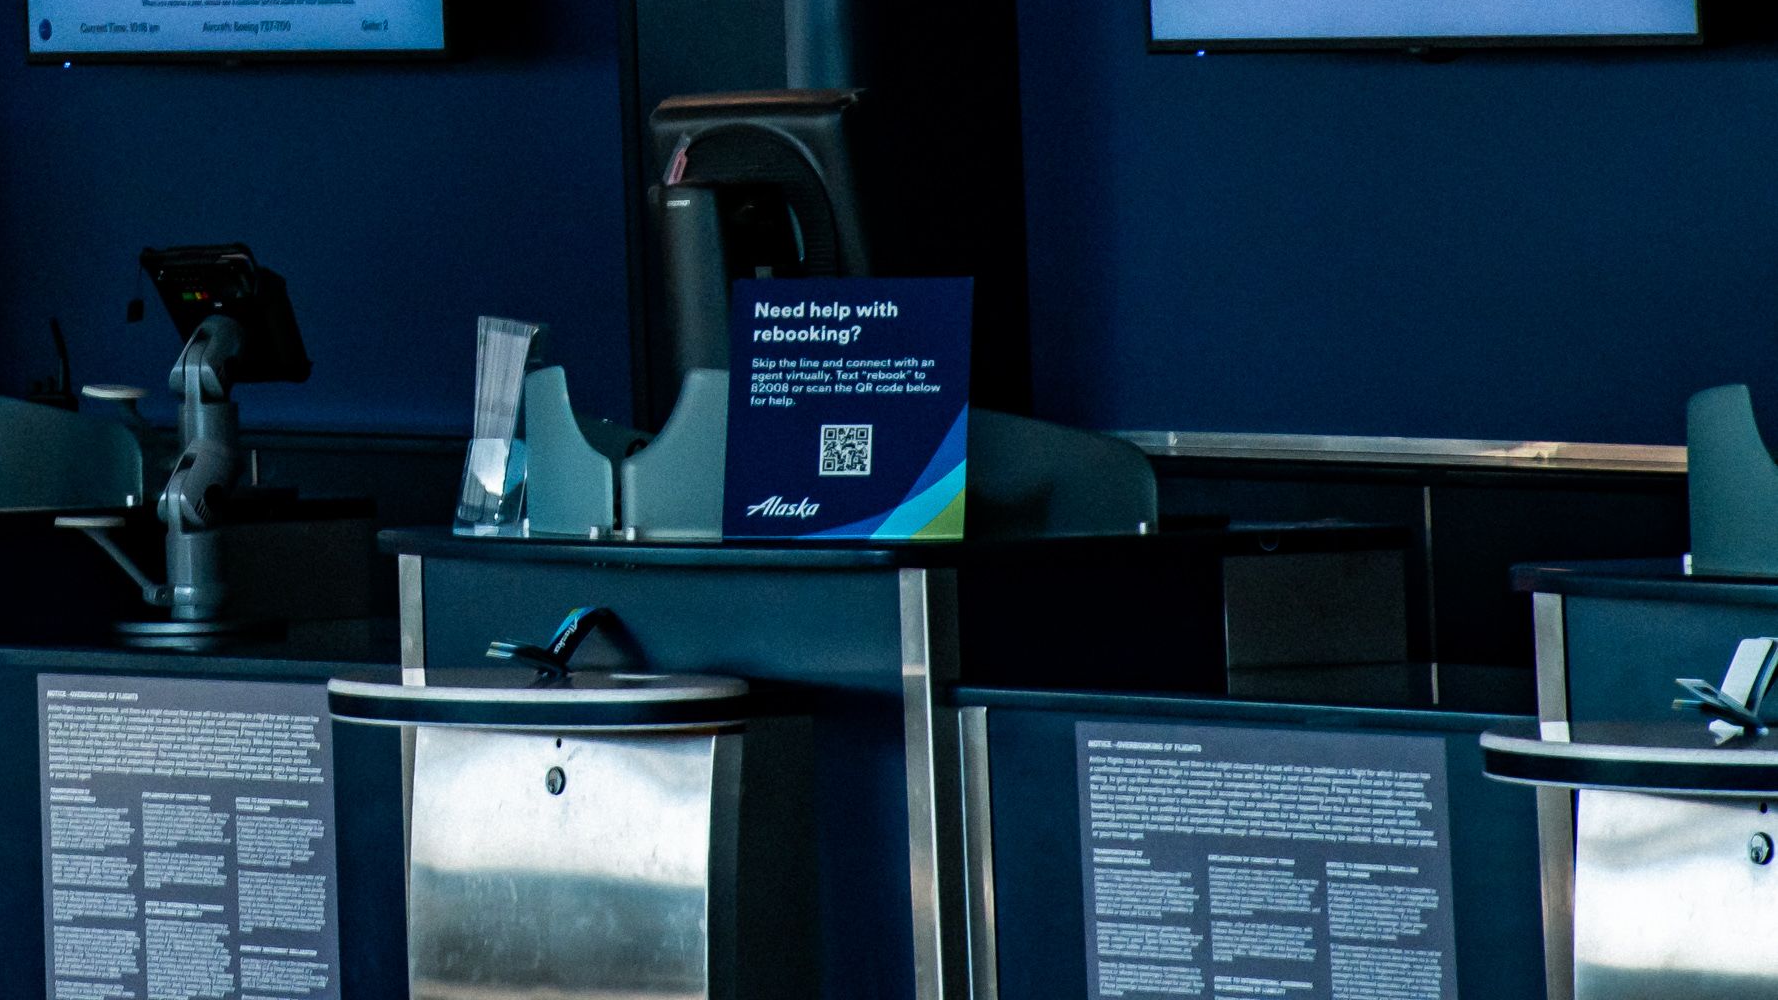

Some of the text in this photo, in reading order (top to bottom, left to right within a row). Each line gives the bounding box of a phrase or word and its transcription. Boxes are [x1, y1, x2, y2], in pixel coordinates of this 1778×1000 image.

[754, 301, 899, 322] Need help with
[753, 325, 862, 345] rebooking?
[752, 357, 935, 370] Skip the line and connect with an
[751, 371, 783, 383] agent
[785, 370, 833, 384] virtually.
[836, 370, 859, 380] Text
[914, 370, 926, 380] to
[792, 385, 803, 394] or
[806, 384, 832, 394] scan
[835, 383, 853, 393] the
[855, 383, 873, 393] QR
[875, 383, 903, 393] code
[906, 382, 941, 393] below
[750, 395, 796, 408] for help.
[746, 495, 820, 519] Alaska
